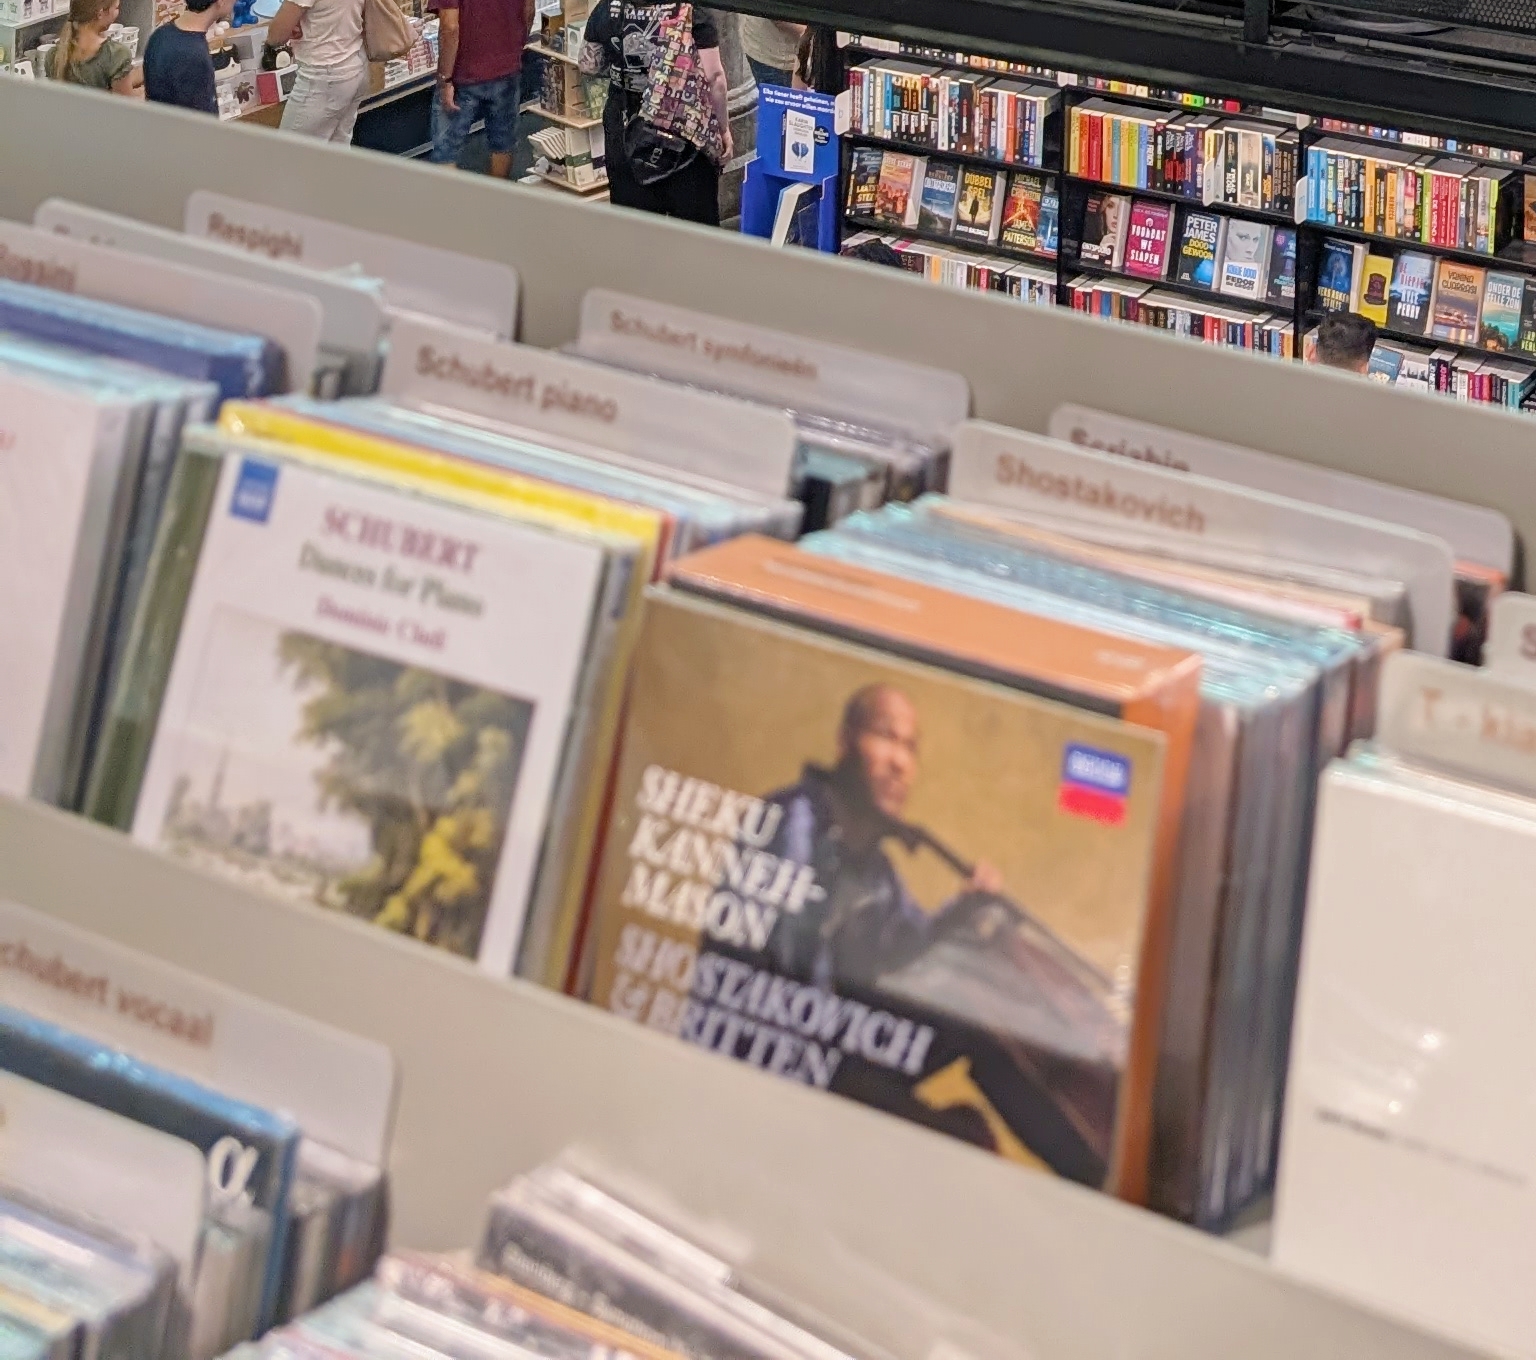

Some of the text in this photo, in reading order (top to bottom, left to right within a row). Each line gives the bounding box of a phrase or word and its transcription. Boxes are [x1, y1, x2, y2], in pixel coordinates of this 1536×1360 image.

[965, 172, 993, 189] DUBBEL
[1015, 173, 1041, 187] MICHAEL
[968, 187, 986, 199] SPEL
[1012, 218, 1032, 231] JAMES
[1186, 215, 1217, 231] PETER
[206, 209, 304, 258] Respighi
[1003, 231, 1036, 247] PATTERSON
[1131, 224, 1166, 240] VOORDAT
[1183, 228, 1216, 243] JAMES
[1141, 239, 1152, 251] WE
[1182, 246, 1214, 260] GEWOON
[1130, 250, 1159, 265] SLAPEN
[1226, 274, 1255, 286] FEDOR
[1487, 281, 1510, 295] ONDER
[1511, 286, 1521, 298] DE
[1396, 302, 1420, 319] PERRY
[1487, 294, 1520, 310] FELLE ZON
[610, 308, 697, 353] Schubert
[416, 341, 618, 423] Schubert piano
[995, 452, 1206, 535] Shostakovich
[319, 505, 484, 577] SCHUBERT
[299, 545, 485, 618] Dances for Piano
[1417, 684, 1440, 723] T
[637, 763, 783, 850] SHEKU
[627, 818, 827, 910] KANNEH-
[620, 868, 777, 952] MASON
[616, 926, 935, 1077] SHOSTAKOVICH
[118, 986, 215, 1048] vocaal
[652, 994, 842, 1090] BRITTEN
